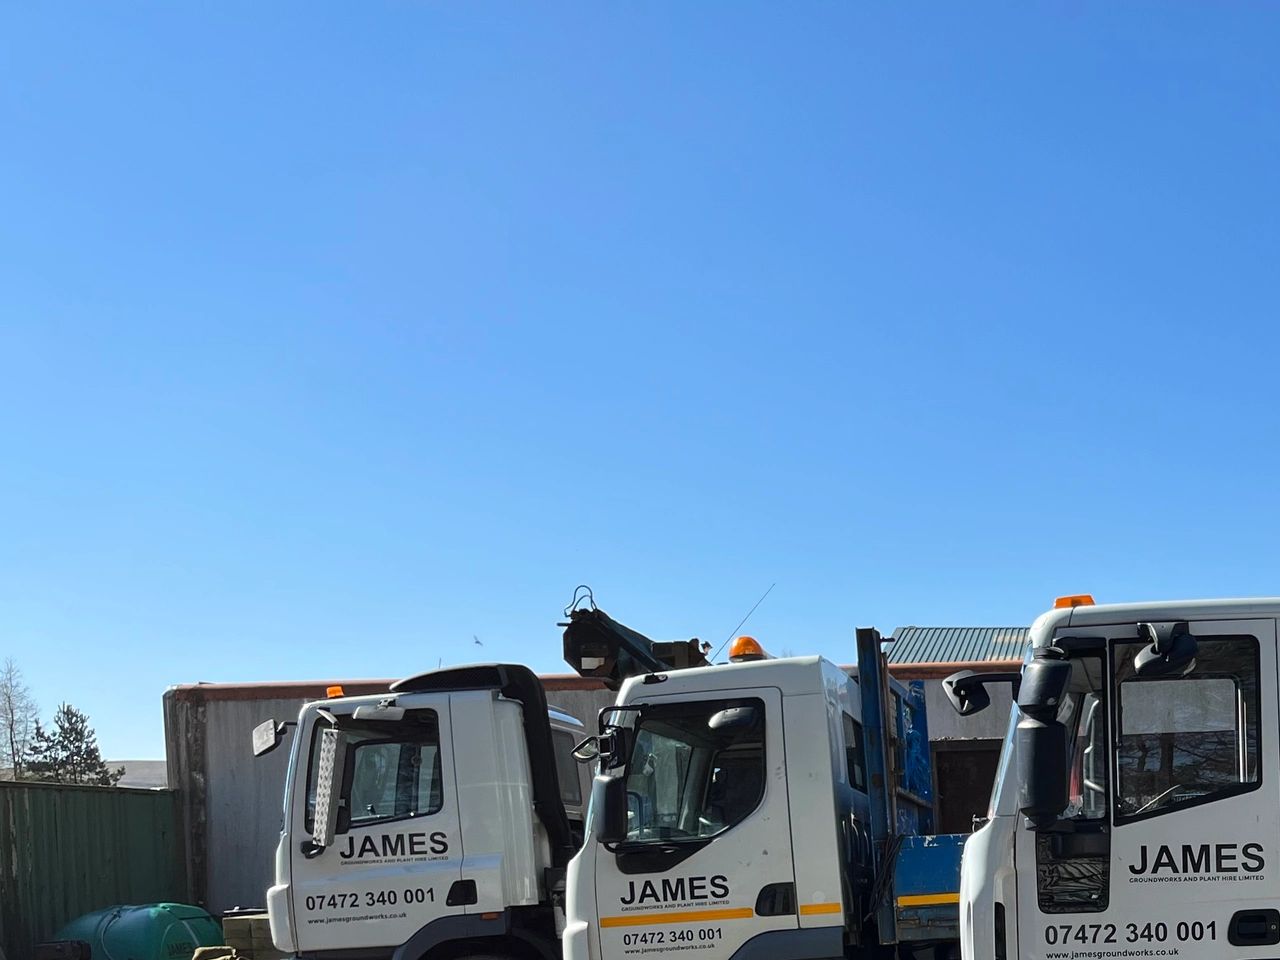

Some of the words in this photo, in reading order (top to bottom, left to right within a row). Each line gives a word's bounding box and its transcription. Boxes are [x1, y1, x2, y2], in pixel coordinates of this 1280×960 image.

[339, 831, 449, 859] JAMES
[1128, 842, 1265, 875] JAMES
[306, 892, 359, 911] 07472
[365, 890, 397, 907] 340
[404, 887, 435, 904] 001
[620, 875, 730, 905] JAMES
[307, 912, 407, 925] www.jamesgroundworks.co.uk
[623, 931, 665, 946] 07472
[669, 929, 694, 943] 340
[698, 928, 722, 940] 001
[1044, 923, 1117, 945] 07472
[1125, 922, 1168, 943] 340
[1176, 920, 1217, 942] 001
[624, 943, 715, 955] www.jamesgroundworks.co.uk
[1046, 947, 1179, 960] www.jamesgroundworks.co.uk
